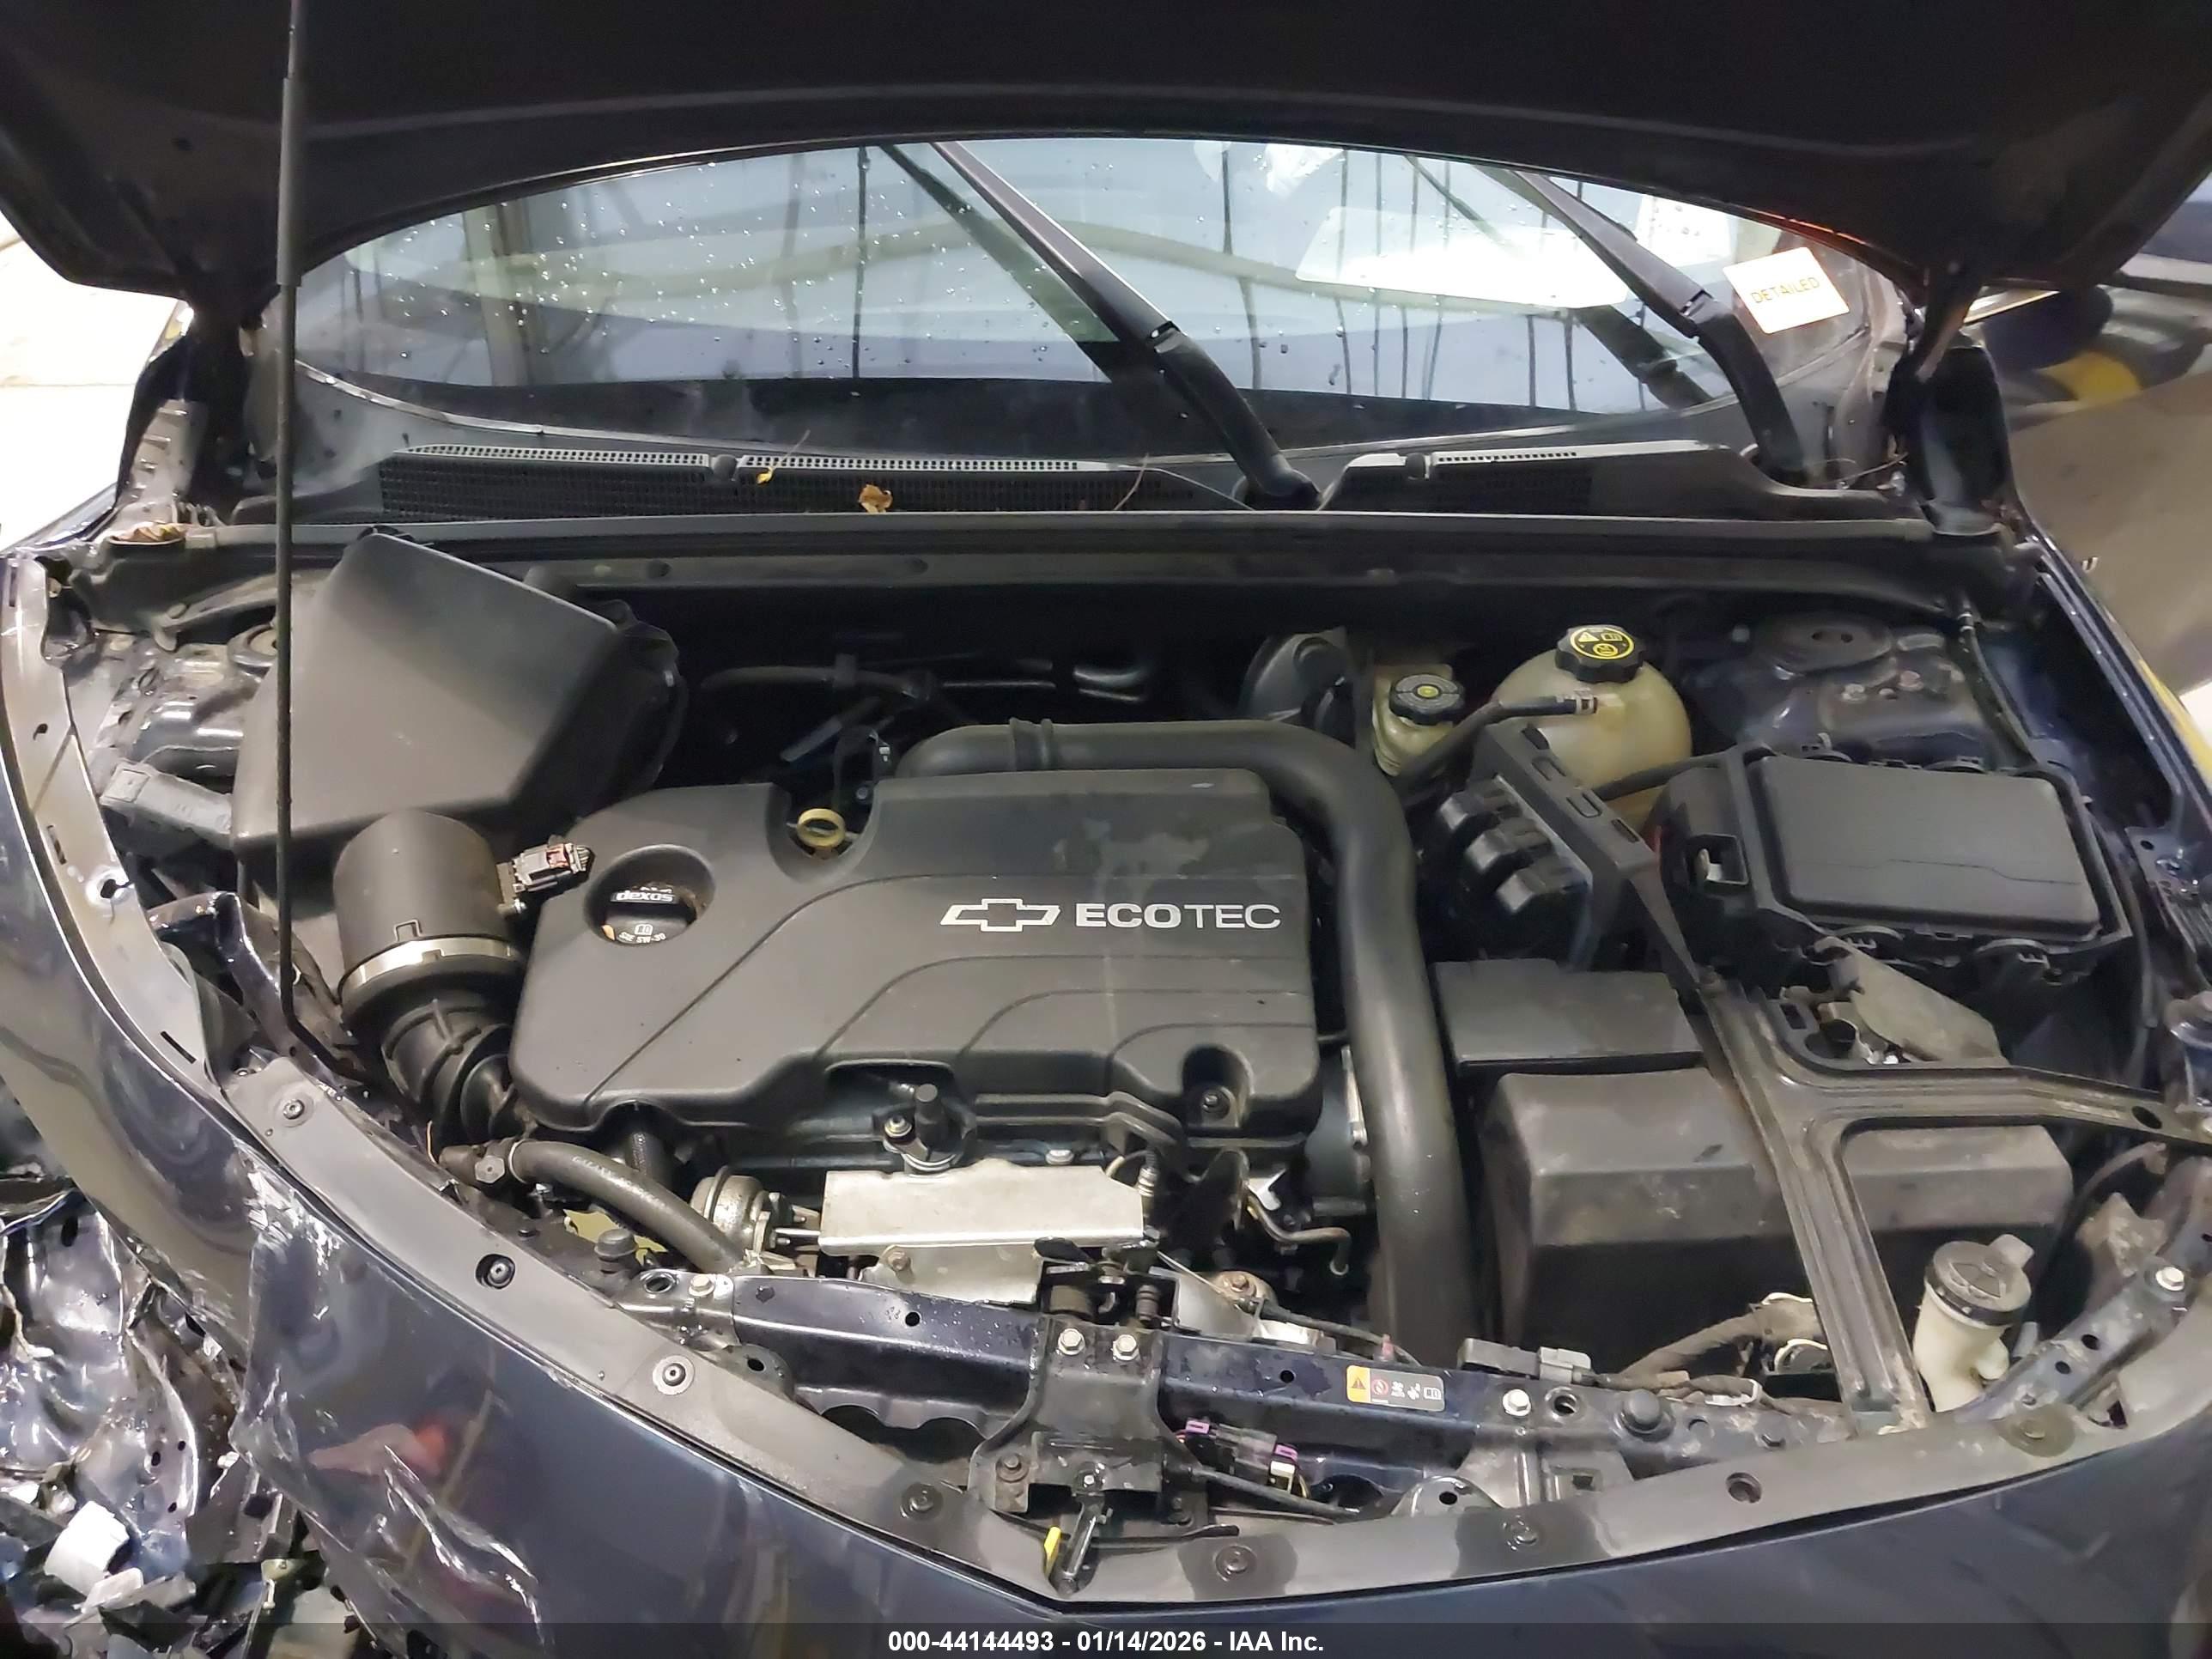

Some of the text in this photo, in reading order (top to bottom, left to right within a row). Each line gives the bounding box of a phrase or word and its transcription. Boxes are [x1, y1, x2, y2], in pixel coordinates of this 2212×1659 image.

[1751, 276, 1820, 303] DETAILED
[616, 890, 675, 902] dexos
[1075, 902, 1281, 929] ECOTEC
[637, 933, 666, 943] 5W-30
